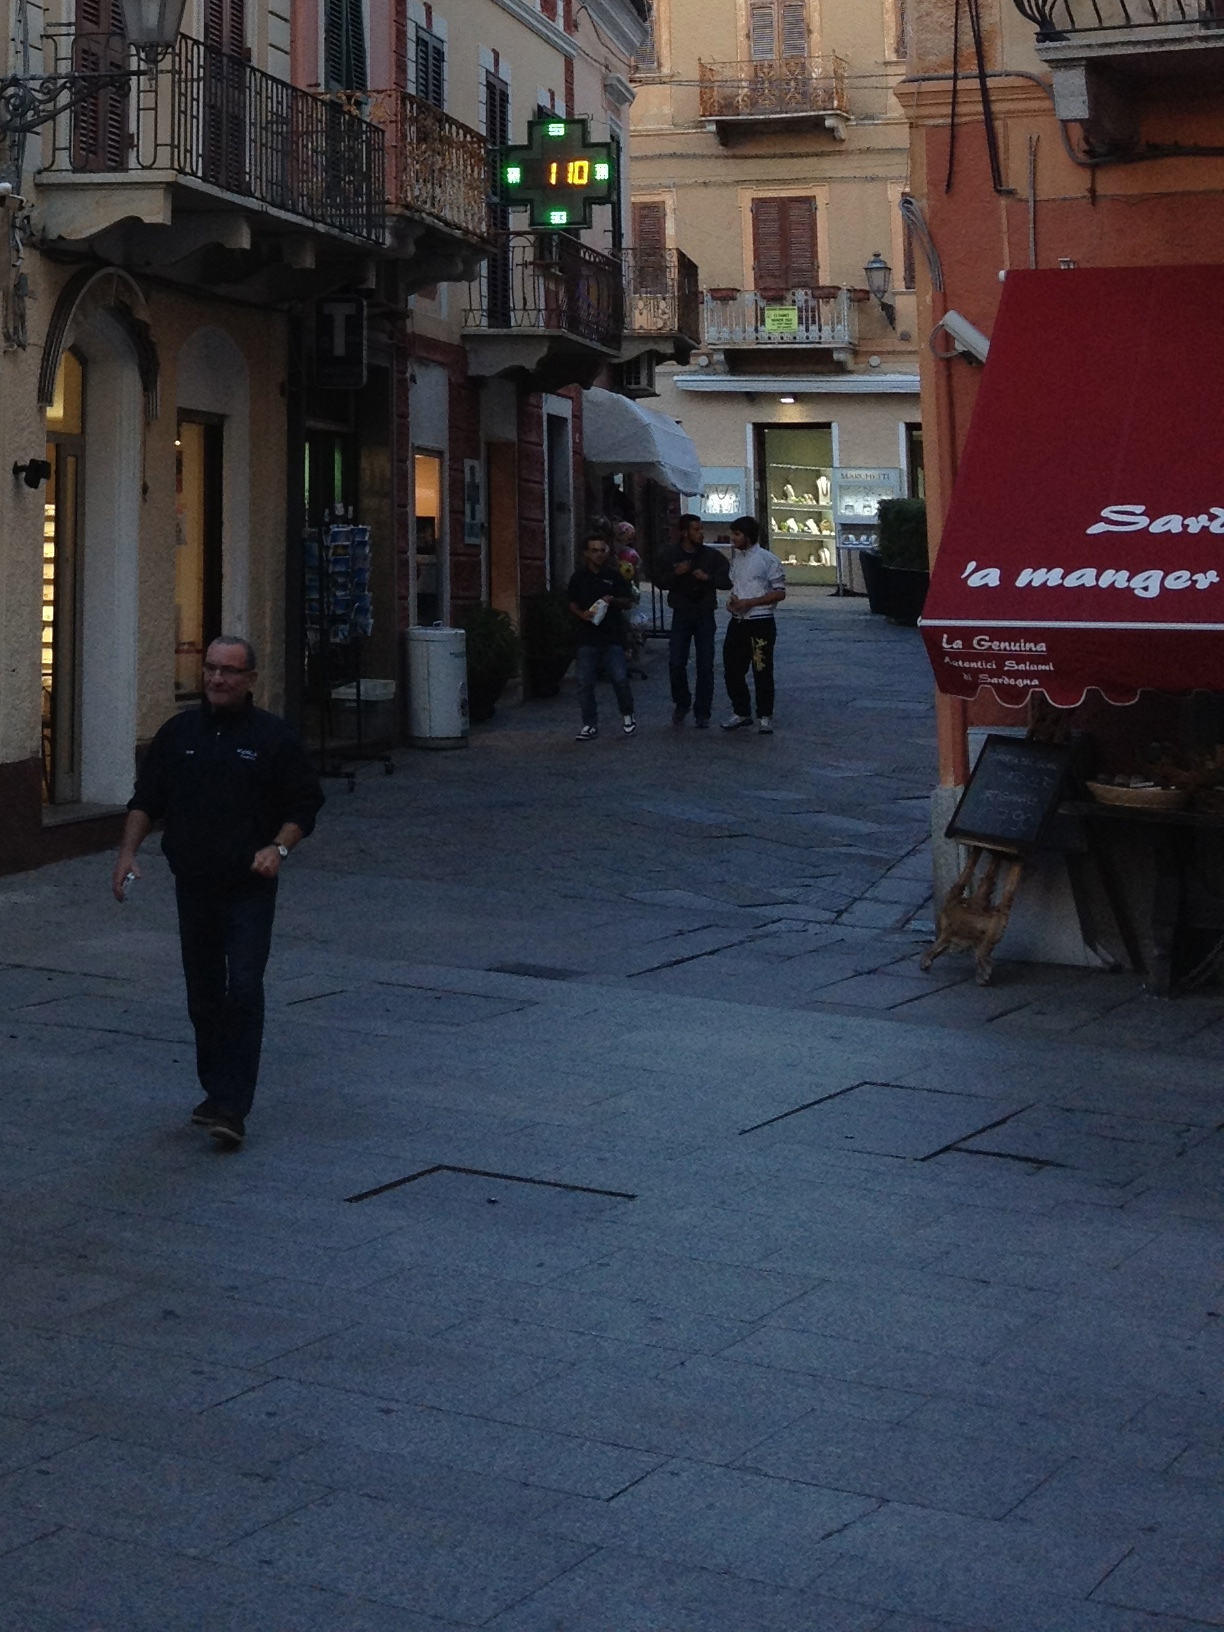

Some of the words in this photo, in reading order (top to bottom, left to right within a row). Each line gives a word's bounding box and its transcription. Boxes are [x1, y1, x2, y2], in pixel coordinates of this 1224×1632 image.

[323, 303, 356, 356] T
[942, 633, 963, 649] La
[973, 635, 1047, 652] Genuina
[944, 656, 997, 670] Autentici
[1003, 660, 1055, 672] Salumi
[978, 673, 1040, 688] Sardegna
